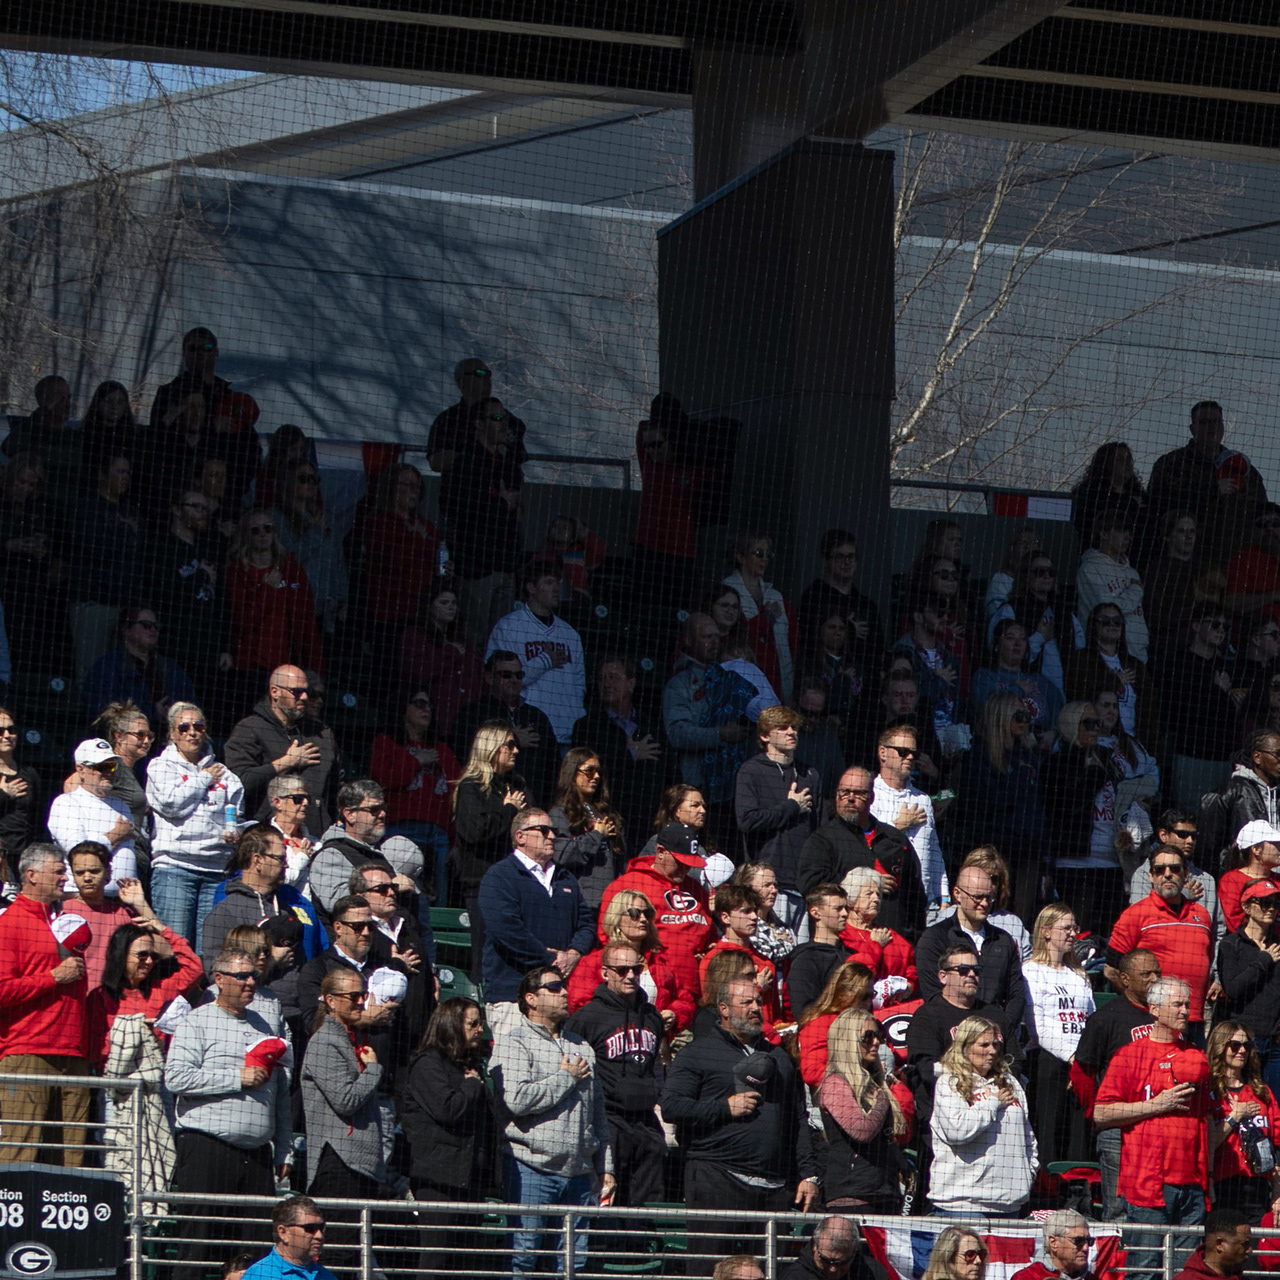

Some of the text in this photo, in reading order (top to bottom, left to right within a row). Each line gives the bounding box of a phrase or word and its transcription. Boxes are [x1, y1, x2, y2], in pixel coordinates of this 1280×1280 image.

[660, 913, 708, 926] GEORGIA
[1054, 986, 1068, 995] IN
[1059, 997, 1075, 1009] MY
[606, 1027, 657, 1059] BULLDOGS
[42, 1191, 87, 1204] Section
[41, 1206, 89, 1230] 209
